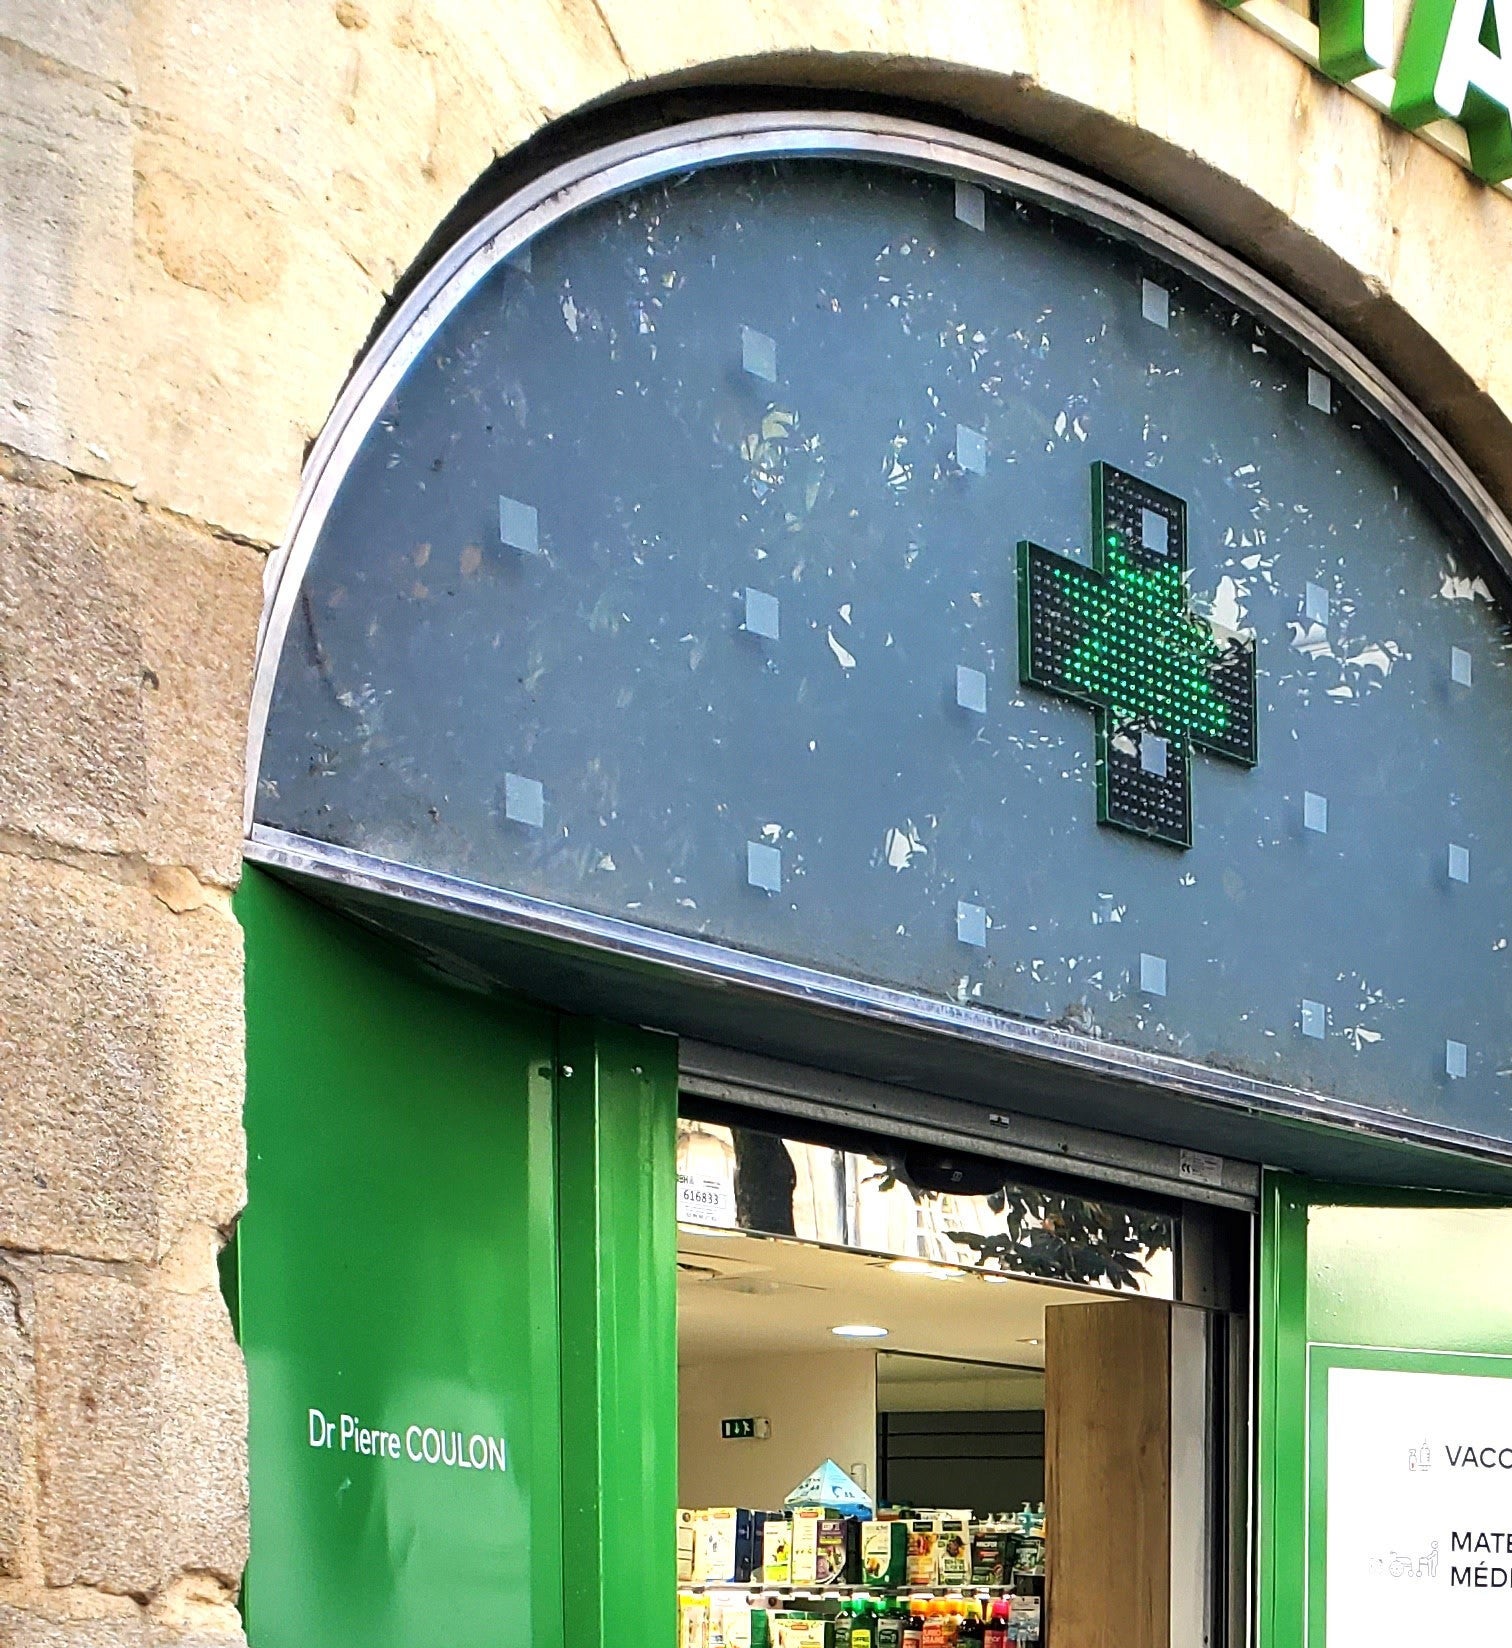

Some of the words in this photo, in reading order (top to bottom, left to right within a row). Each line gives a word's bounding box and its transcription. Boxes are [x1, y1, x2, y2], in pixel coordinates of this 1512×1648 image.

[683, 1189, 719, 1205] 616833
[309, 1408, 336, 1448] Dr
[340, 1414, 401, 1460] Pierre
[406, 1425, 506, 1472] COULON
